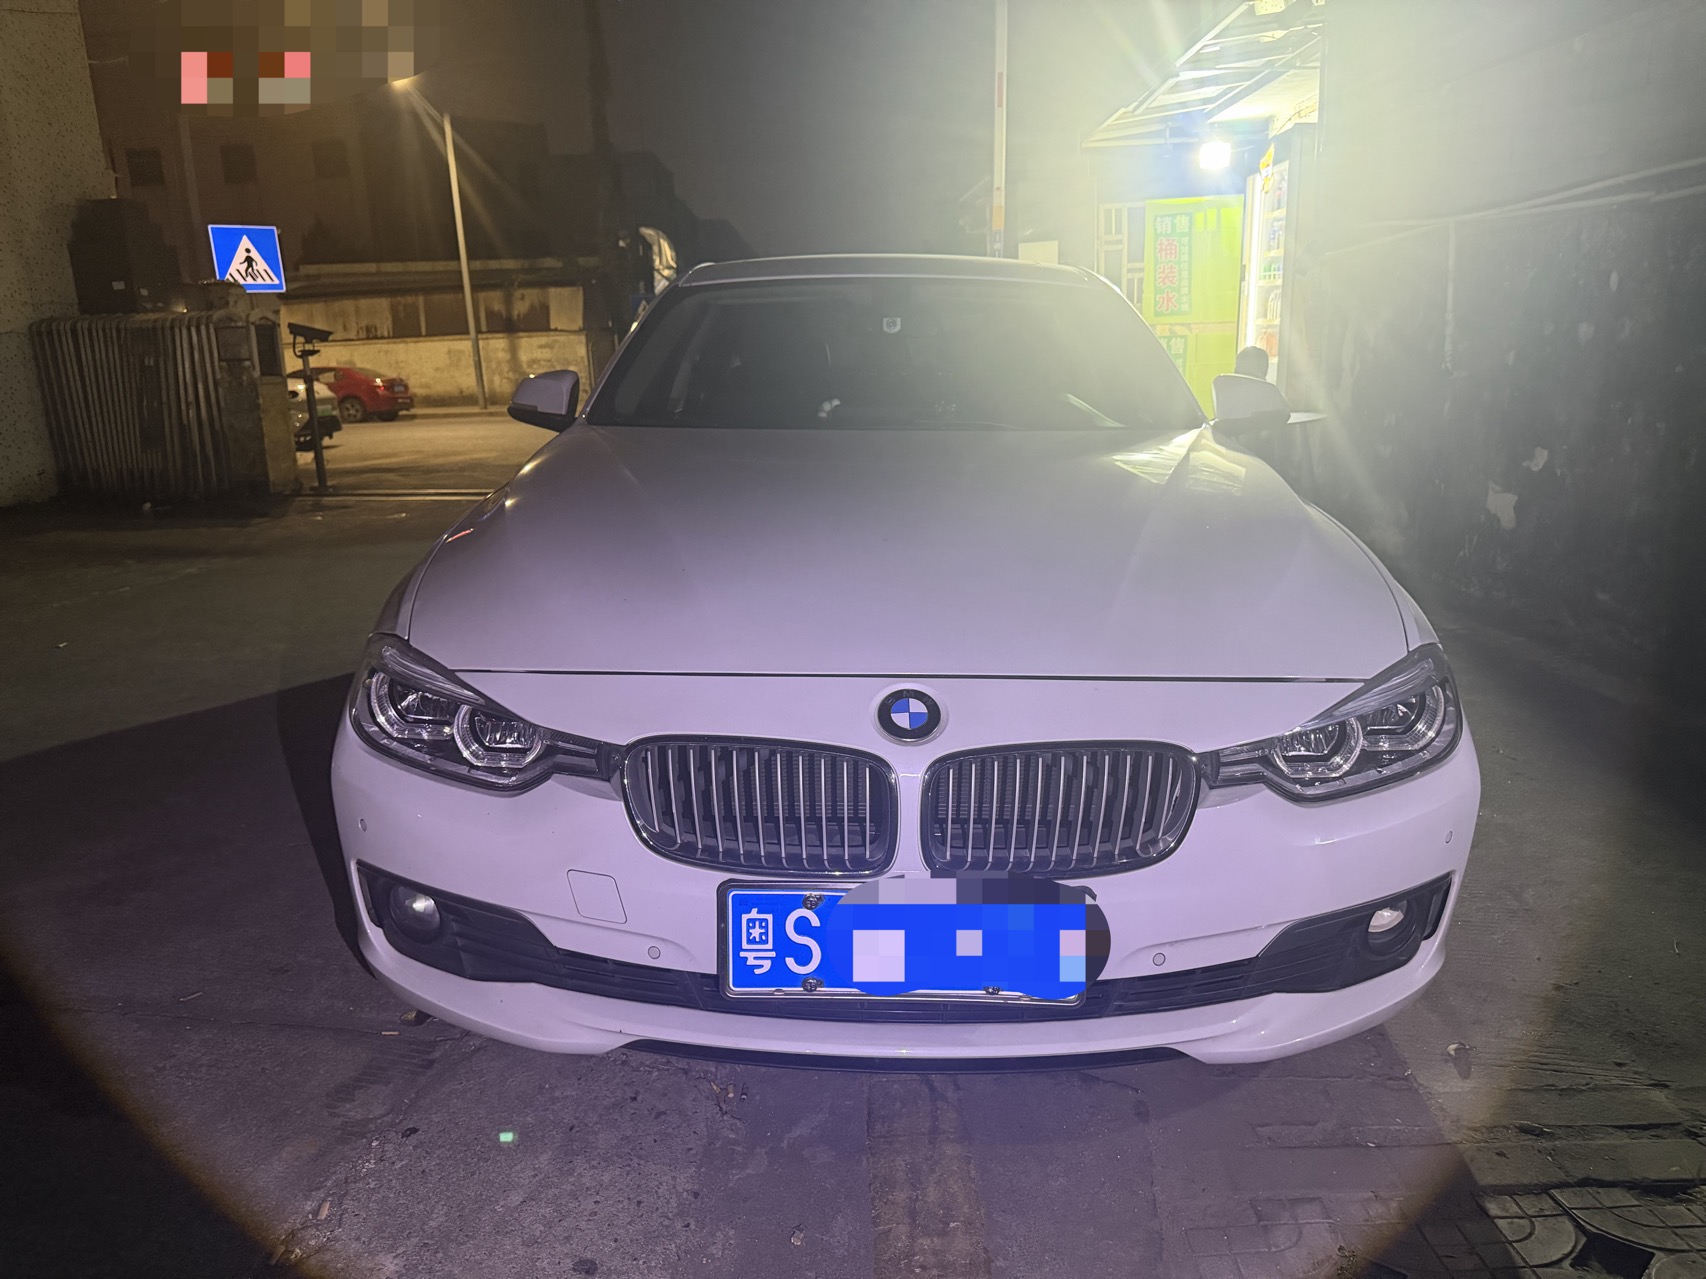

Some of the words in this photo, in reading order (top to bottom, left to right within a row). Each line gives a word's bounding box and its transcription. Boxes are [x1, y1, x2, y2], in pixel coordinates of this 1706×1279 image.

[1155, 214, 1190, 234] 销售
[1156, 237, 1178, 313] 桶装水
[885, 690, 934, 706] BMW
